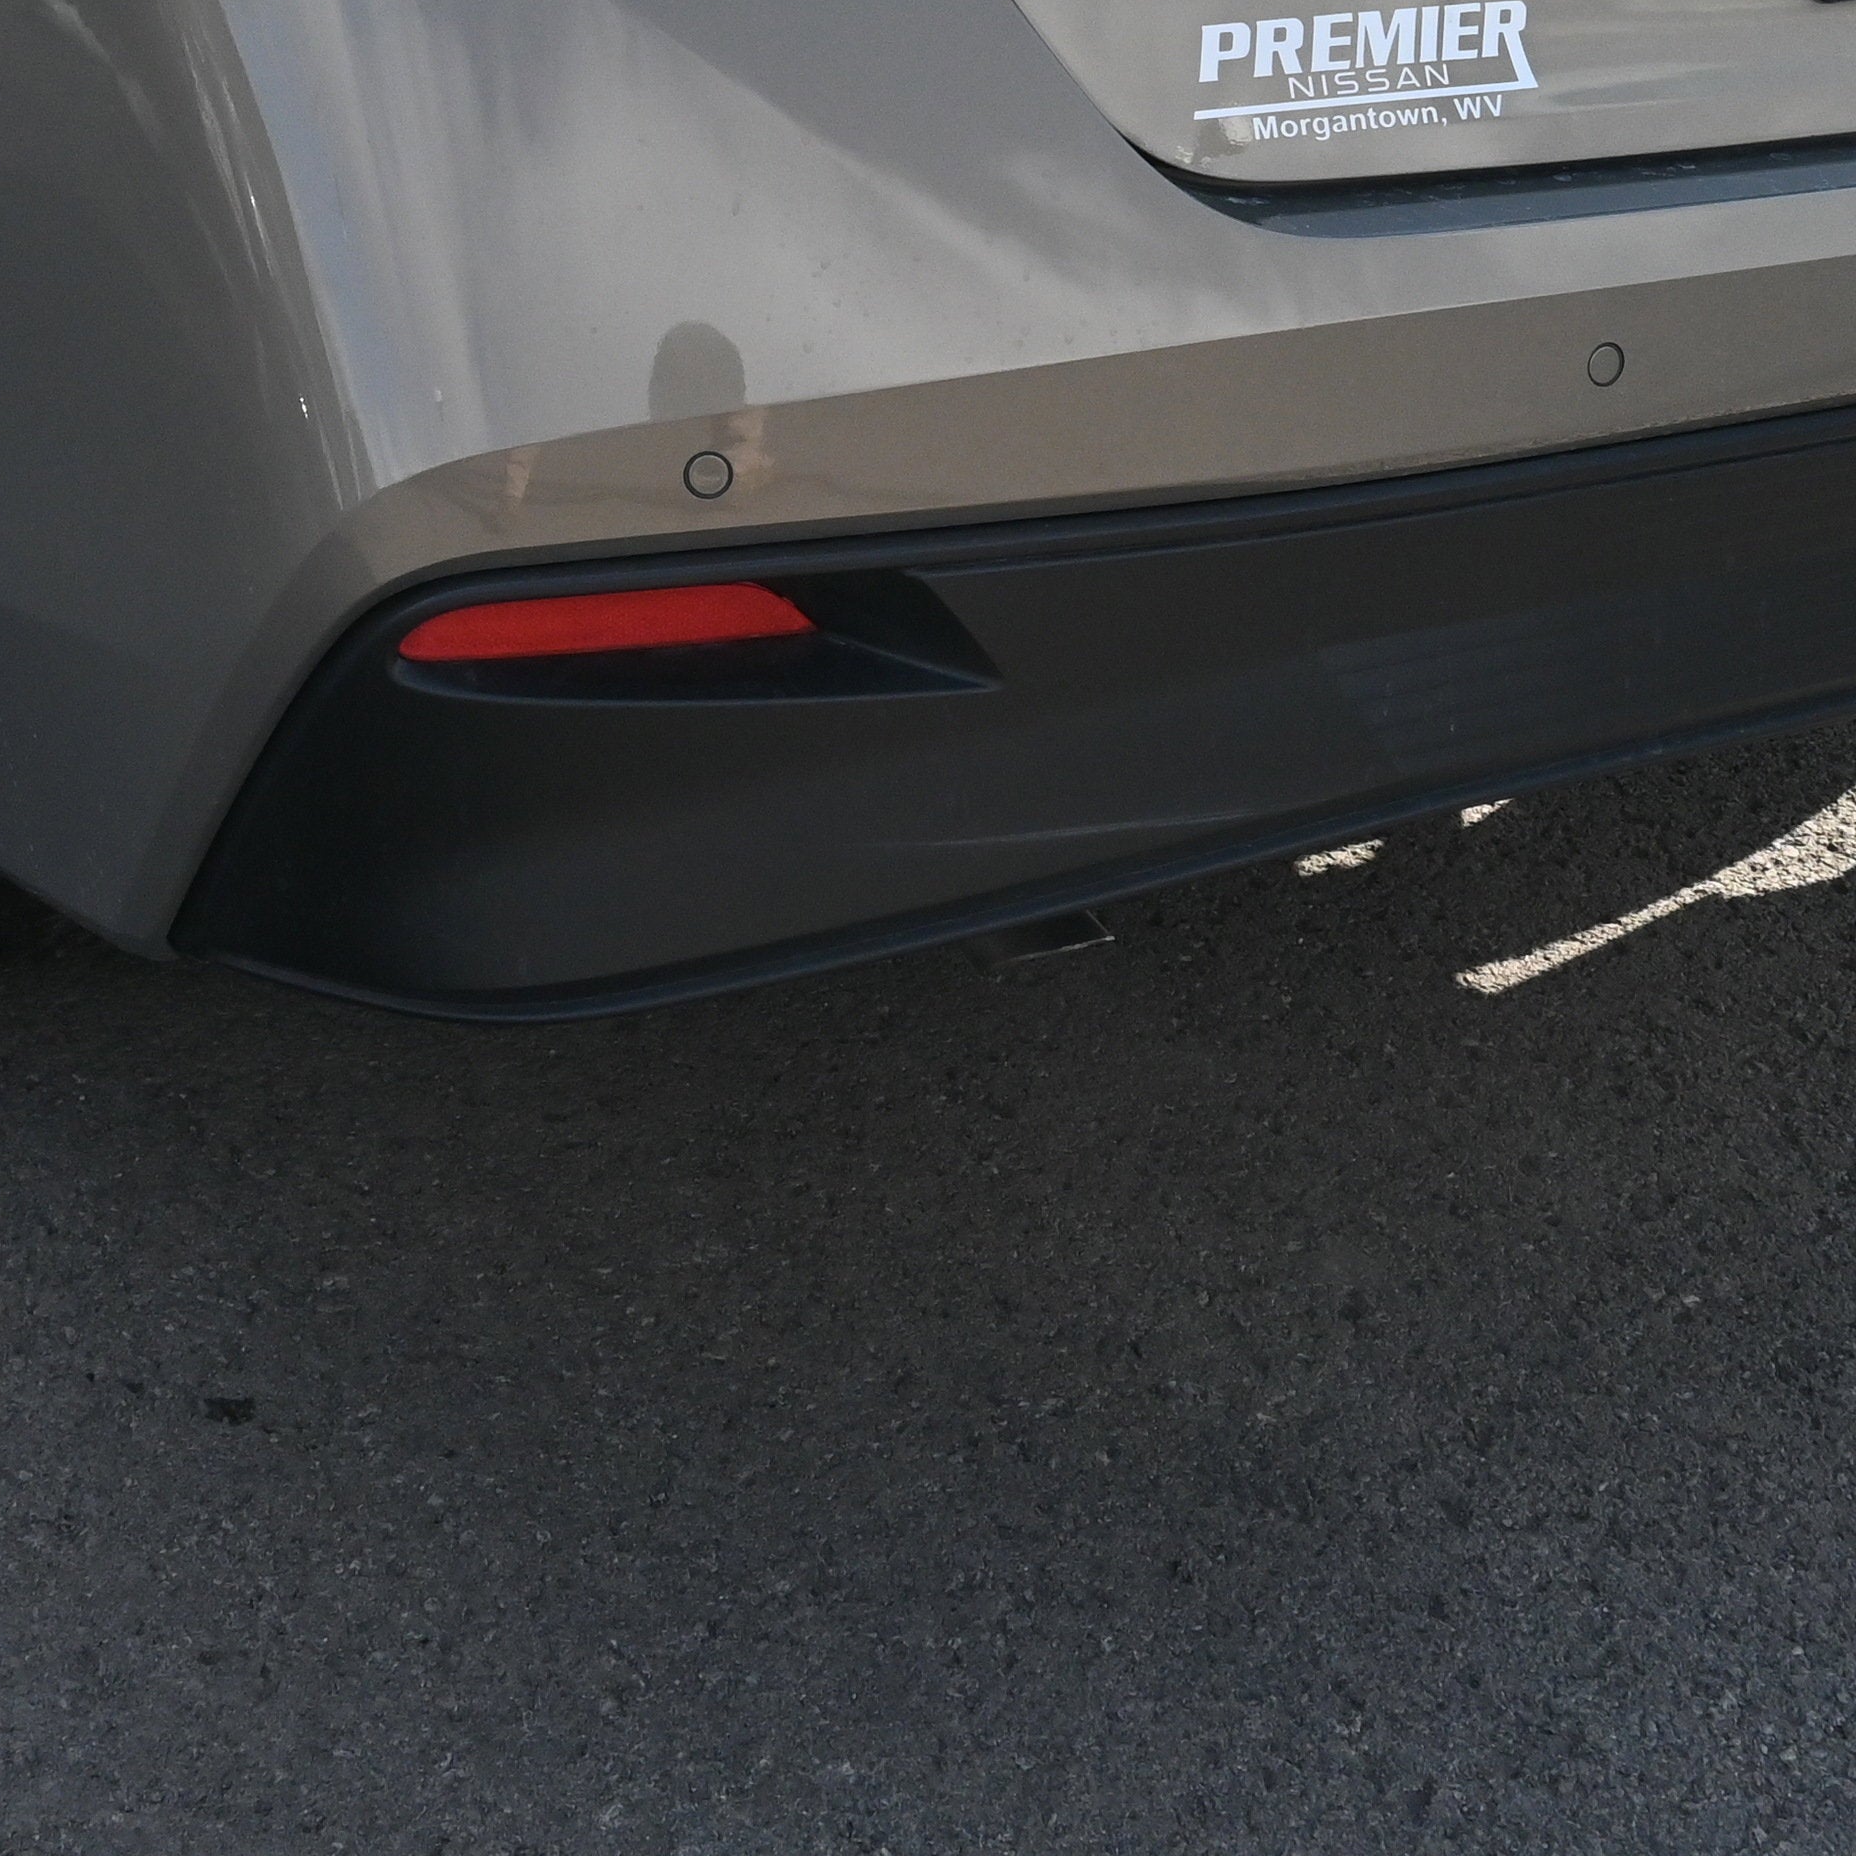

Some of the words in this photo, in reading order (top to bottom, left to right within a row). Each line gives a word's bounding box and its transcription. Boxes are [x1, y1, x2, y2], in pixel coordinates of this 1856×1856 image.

[1198, 0, 1539, 83] PREMIER
[1288, 63, 1450, 99] NISSAN
[1252, 105, 1447, 142] Morgantown,
[1453, 95, 1502, 120] WV
